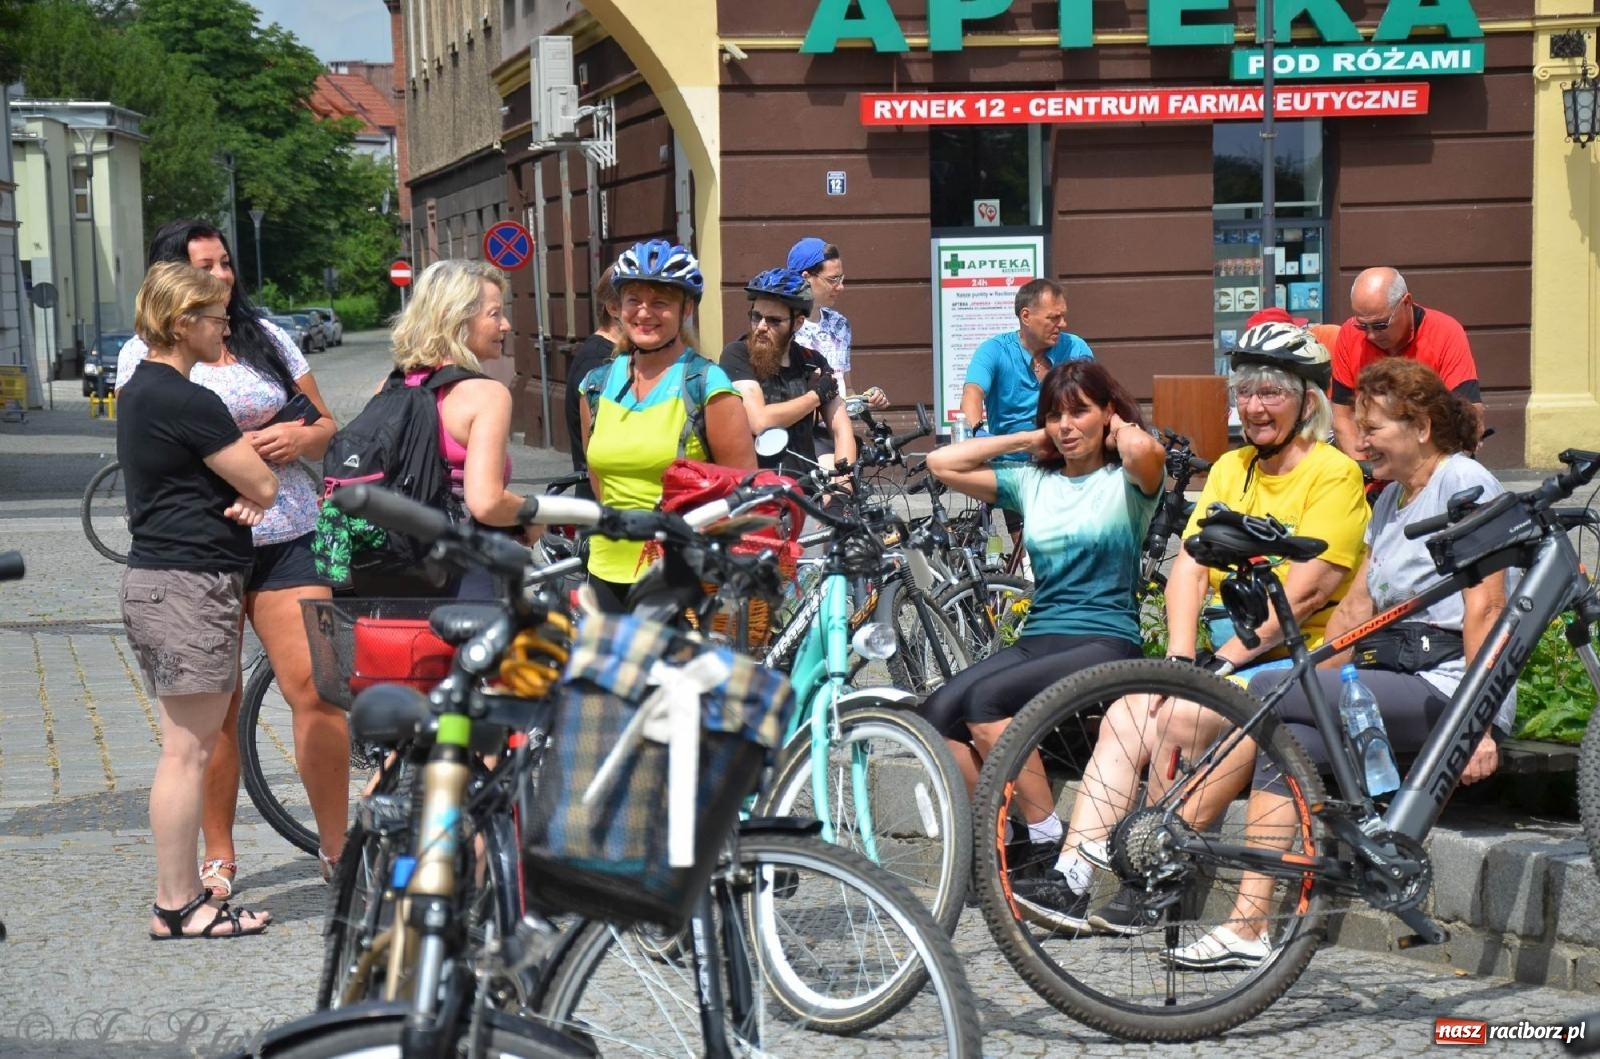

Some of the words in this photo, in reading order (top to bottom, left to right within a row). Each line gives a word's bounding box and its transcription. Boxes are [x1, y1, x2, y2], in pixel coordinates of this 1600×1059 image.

[1248, 54, 1320, 75] POD
[1332, 47, 1471, 72] RÓŻAMI
[874, 99, 966, 119] RYNEK
[975, 98, 1005, 118] 12
[1029, 95, 1159, 116] CENTRUM
[830, 180, 842, 190] 12
[967, 259, 1030, 270] APTEKA
[971, 279, 988, 287] 24h
[1429, 637, 1527, 802] MAXBIKE
